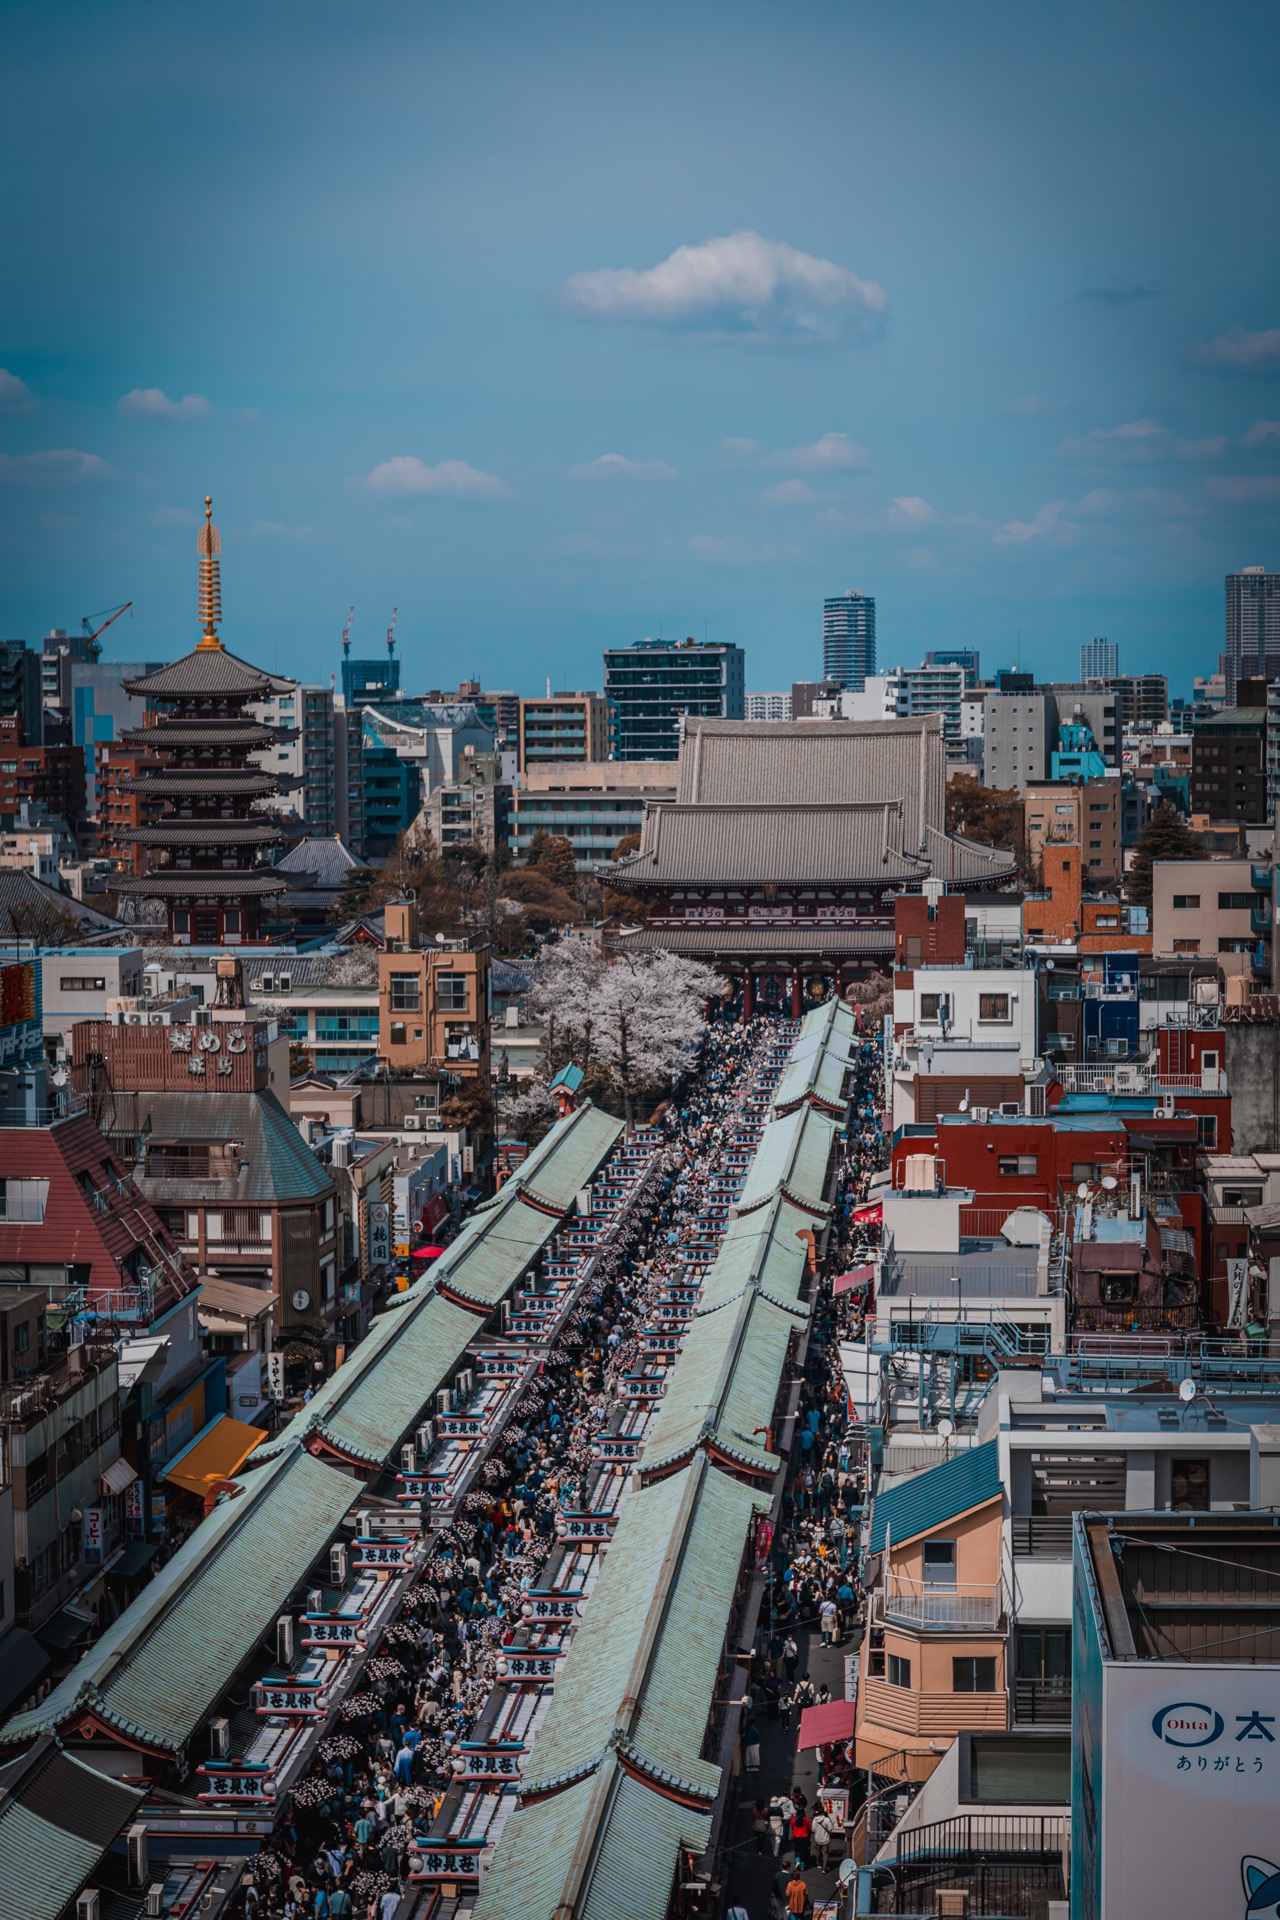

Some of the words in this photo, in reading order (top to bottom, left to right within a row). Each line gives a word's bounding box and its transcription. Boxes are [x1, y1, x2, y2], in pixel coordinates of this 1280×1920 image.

[711, 1196, 731, 1204] 仲見世
[699, 1222, 721, 1230] 仲見世
[687, 1252, 710, 1260] 仲見世
[670, 1291, 694, 1300] 仲見世
[662, 1309, 688, 1318] 仲見世
[649, 1339, 676, 1349] 仲見世
[630, 1384, 658, 1394] 仲見世
[604, 1445, 635, 1456] 仲見世
[126, 1484, 134, 1517] オムライス
[90, 1512, 100, 1544] コーヒー
[570, 1523, 604, 1535] 仲見世
[536, 1603, 574, 1616] 仲見世
[511, 1660, 551, 1674] 仲見世
[1167, 1719, 1209, 1731] Ohta
[469, 1757, 512, 1772] 仲見世
[1176, 1755, 1263, 1773] ありがとう
[427, 1854, 474, 1872] 仲見世
